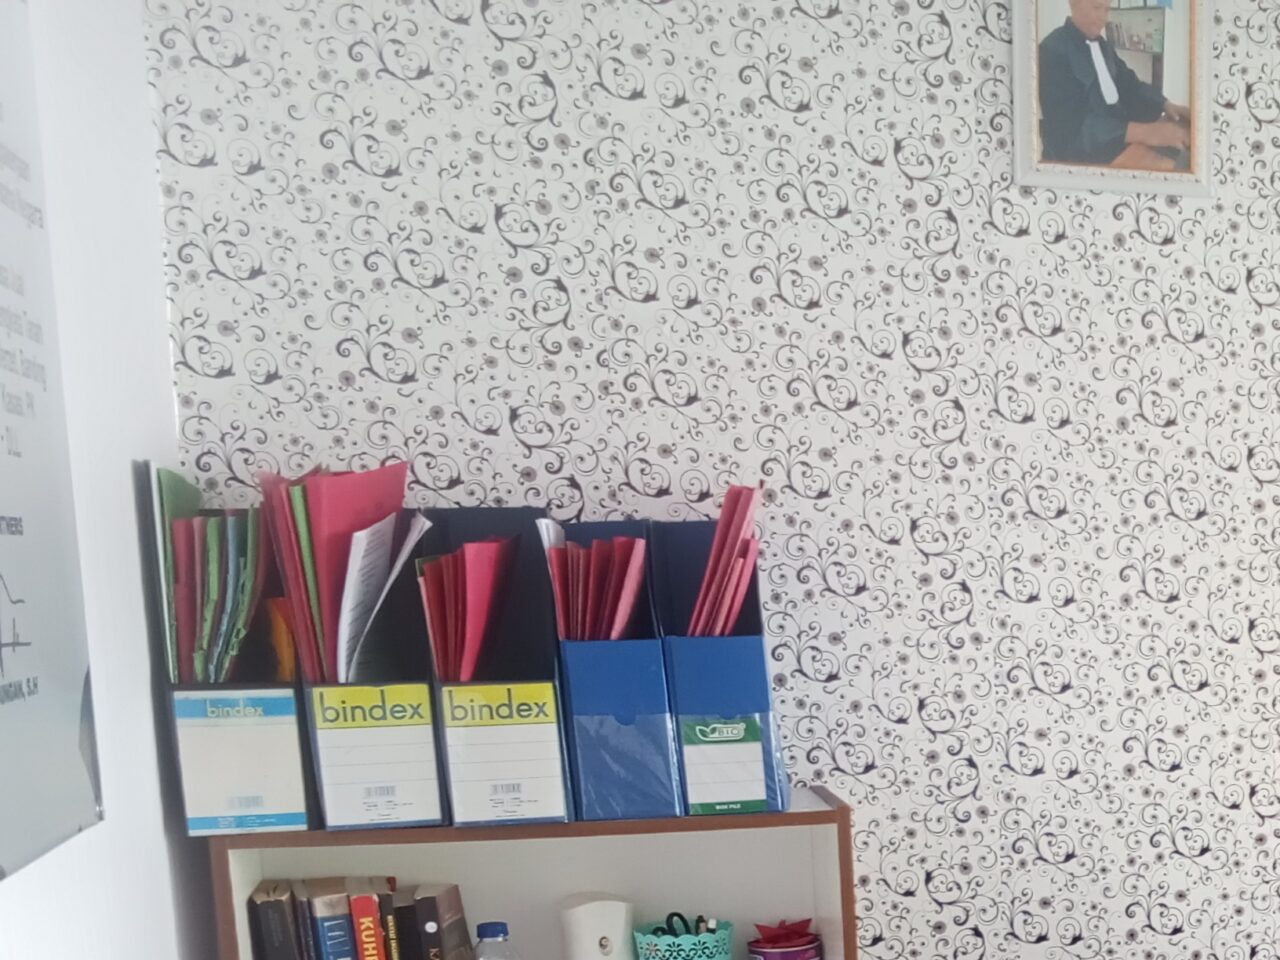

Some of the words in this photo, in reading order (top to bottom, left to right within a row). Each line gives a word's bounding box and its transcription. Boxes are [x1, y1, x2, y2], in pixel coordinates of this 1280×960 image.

[206, 698, 264, 718] bindex
[319, 689, 424, 723] bindex
[448, 688, 549, 721] bindex
